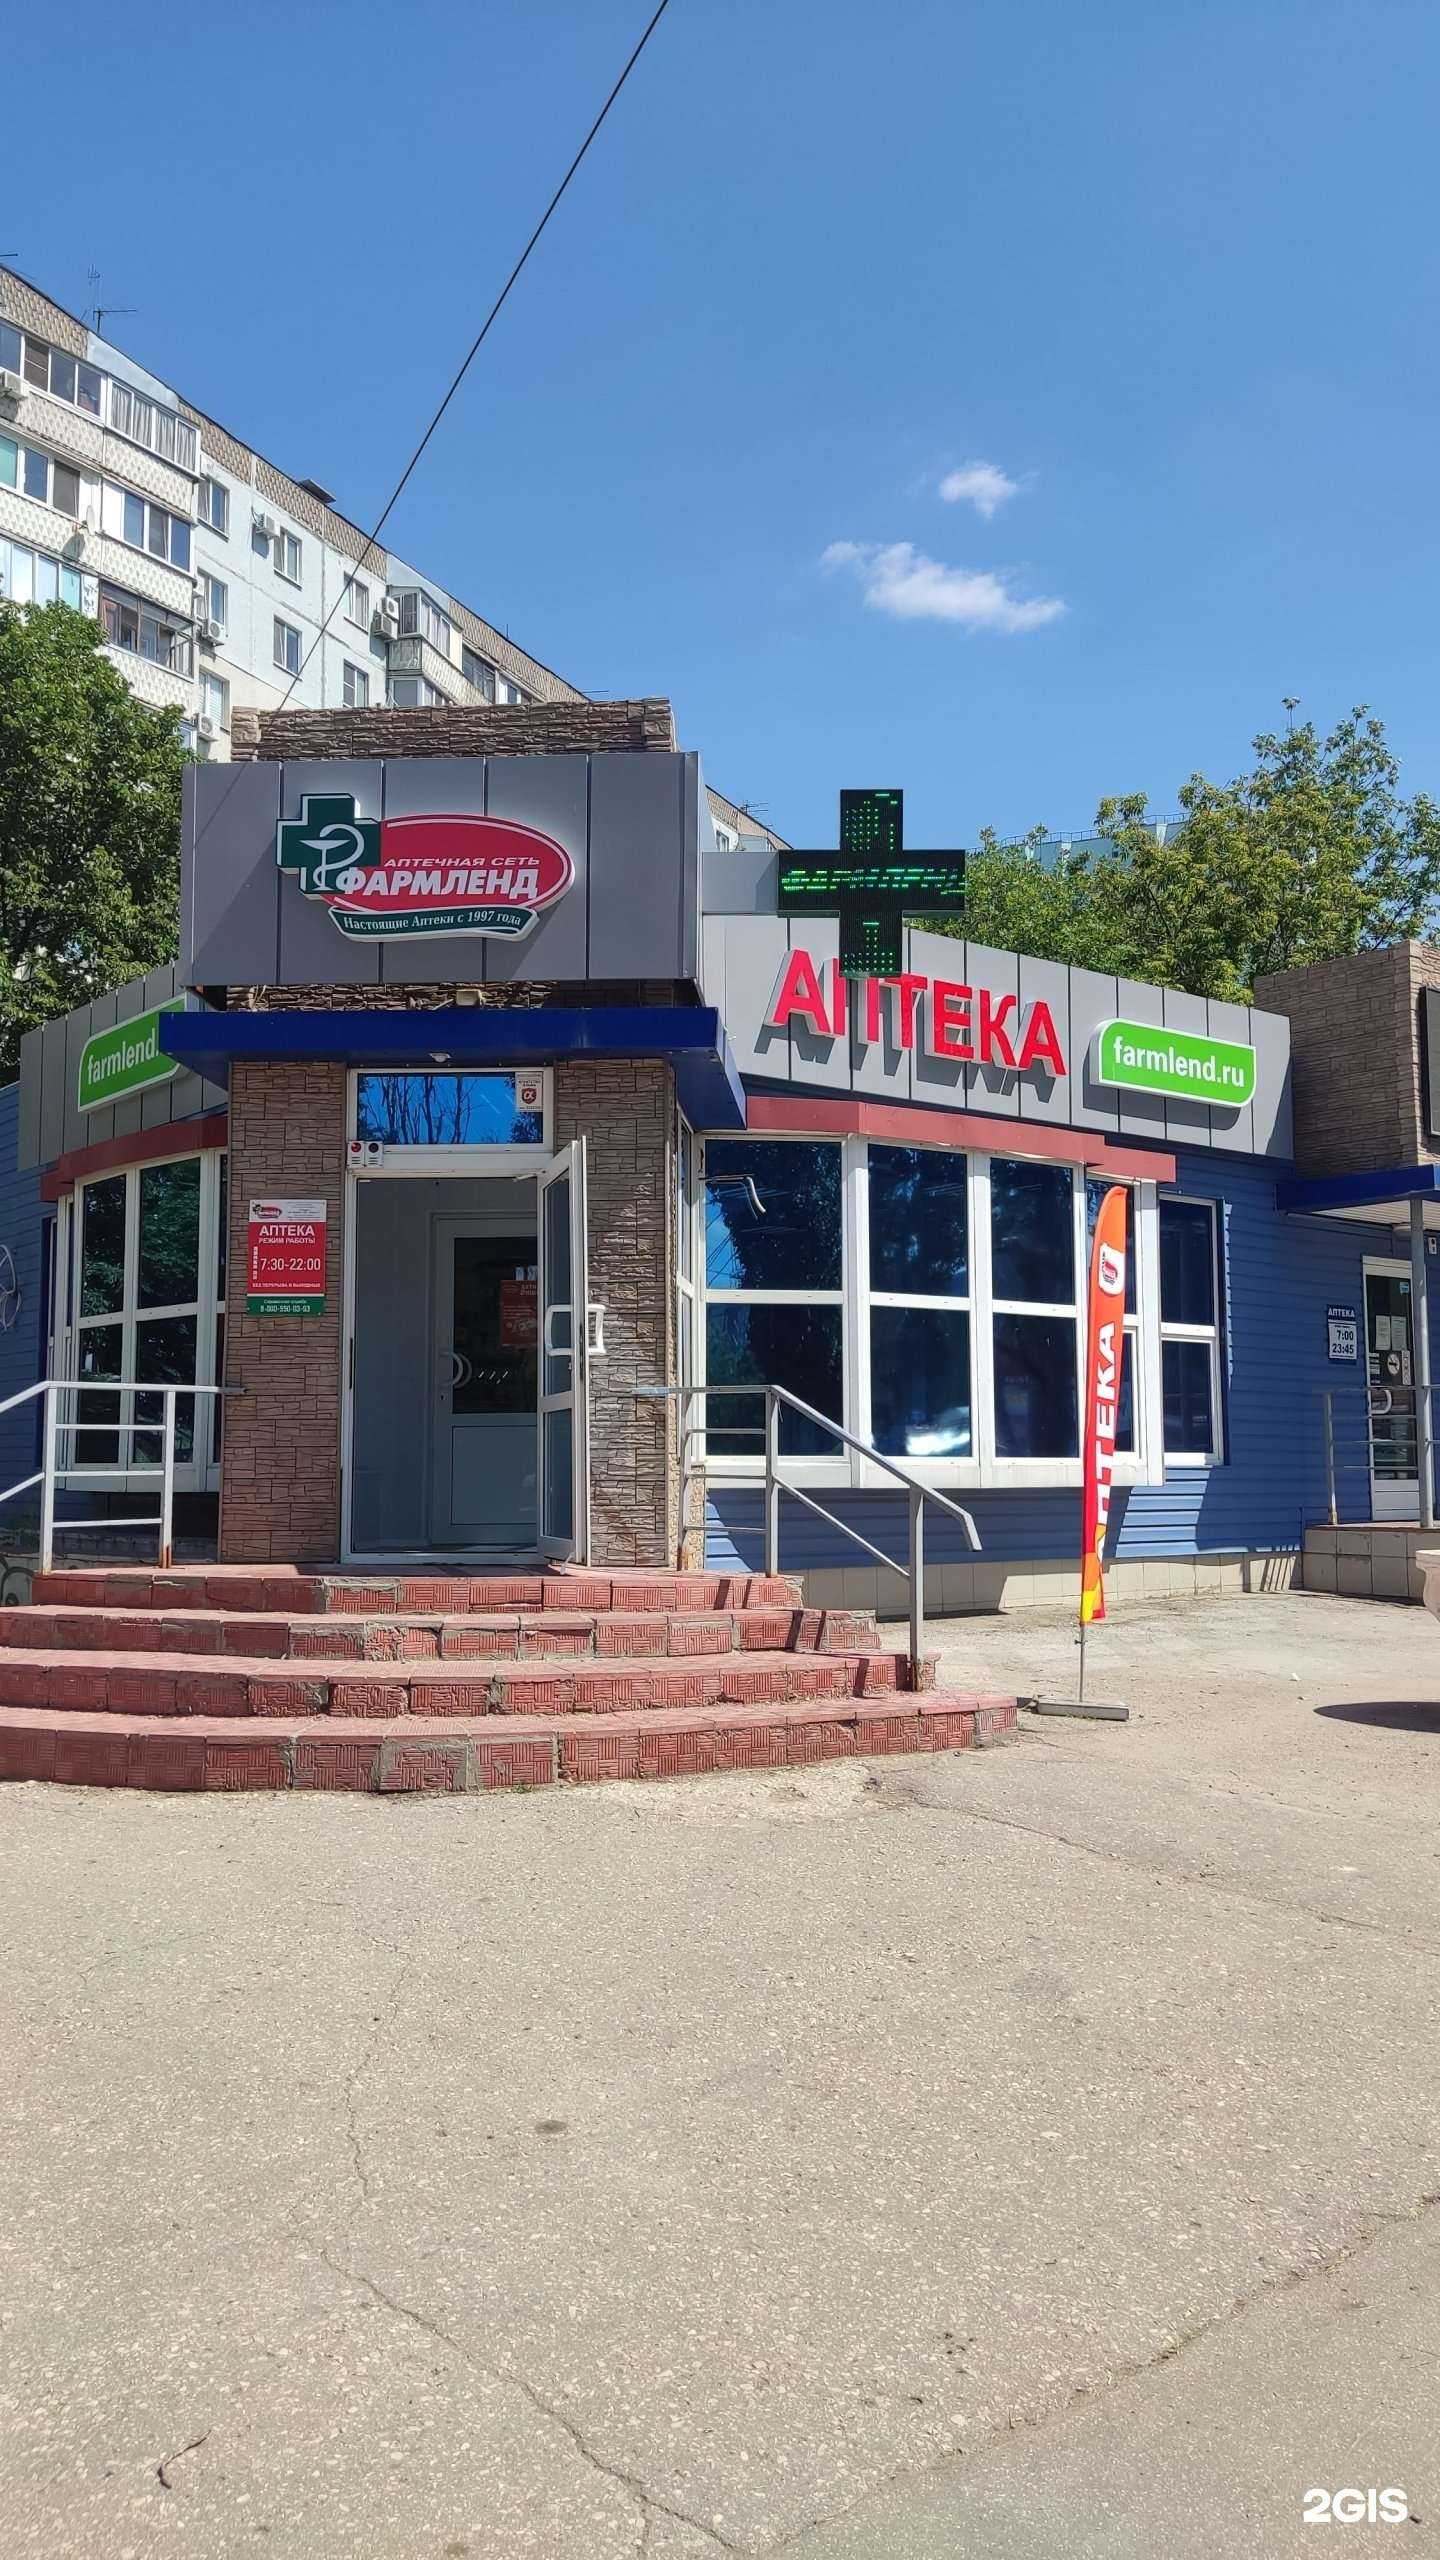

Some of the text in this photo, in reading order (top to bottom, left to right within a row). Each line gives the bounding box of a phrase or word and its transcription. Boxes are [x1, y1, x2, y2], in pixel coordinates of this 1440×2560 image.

[384, 856, 541, 868] АПТЕЧНАЯ СЕТЬ
[335, 866, 540, 900] ФАРМЛЕНД
[343, 911, 522, 931] Настоящие Аптеки с 1997 года
[87, 1027, 160, 1085] farmlend.
[1113, 1036, 1245, 1088] farmlend.ru
[259, 1224, 315, 1236] АПТЕКА
[260, 1258, 321, 1271] 7:30-22:00
[1328, 1307, 1355, 1318] АПТЕКА
[1336, 1329, 1354, 1341] 7:00
[1331, 1343, 1354, 1354] 23:45
